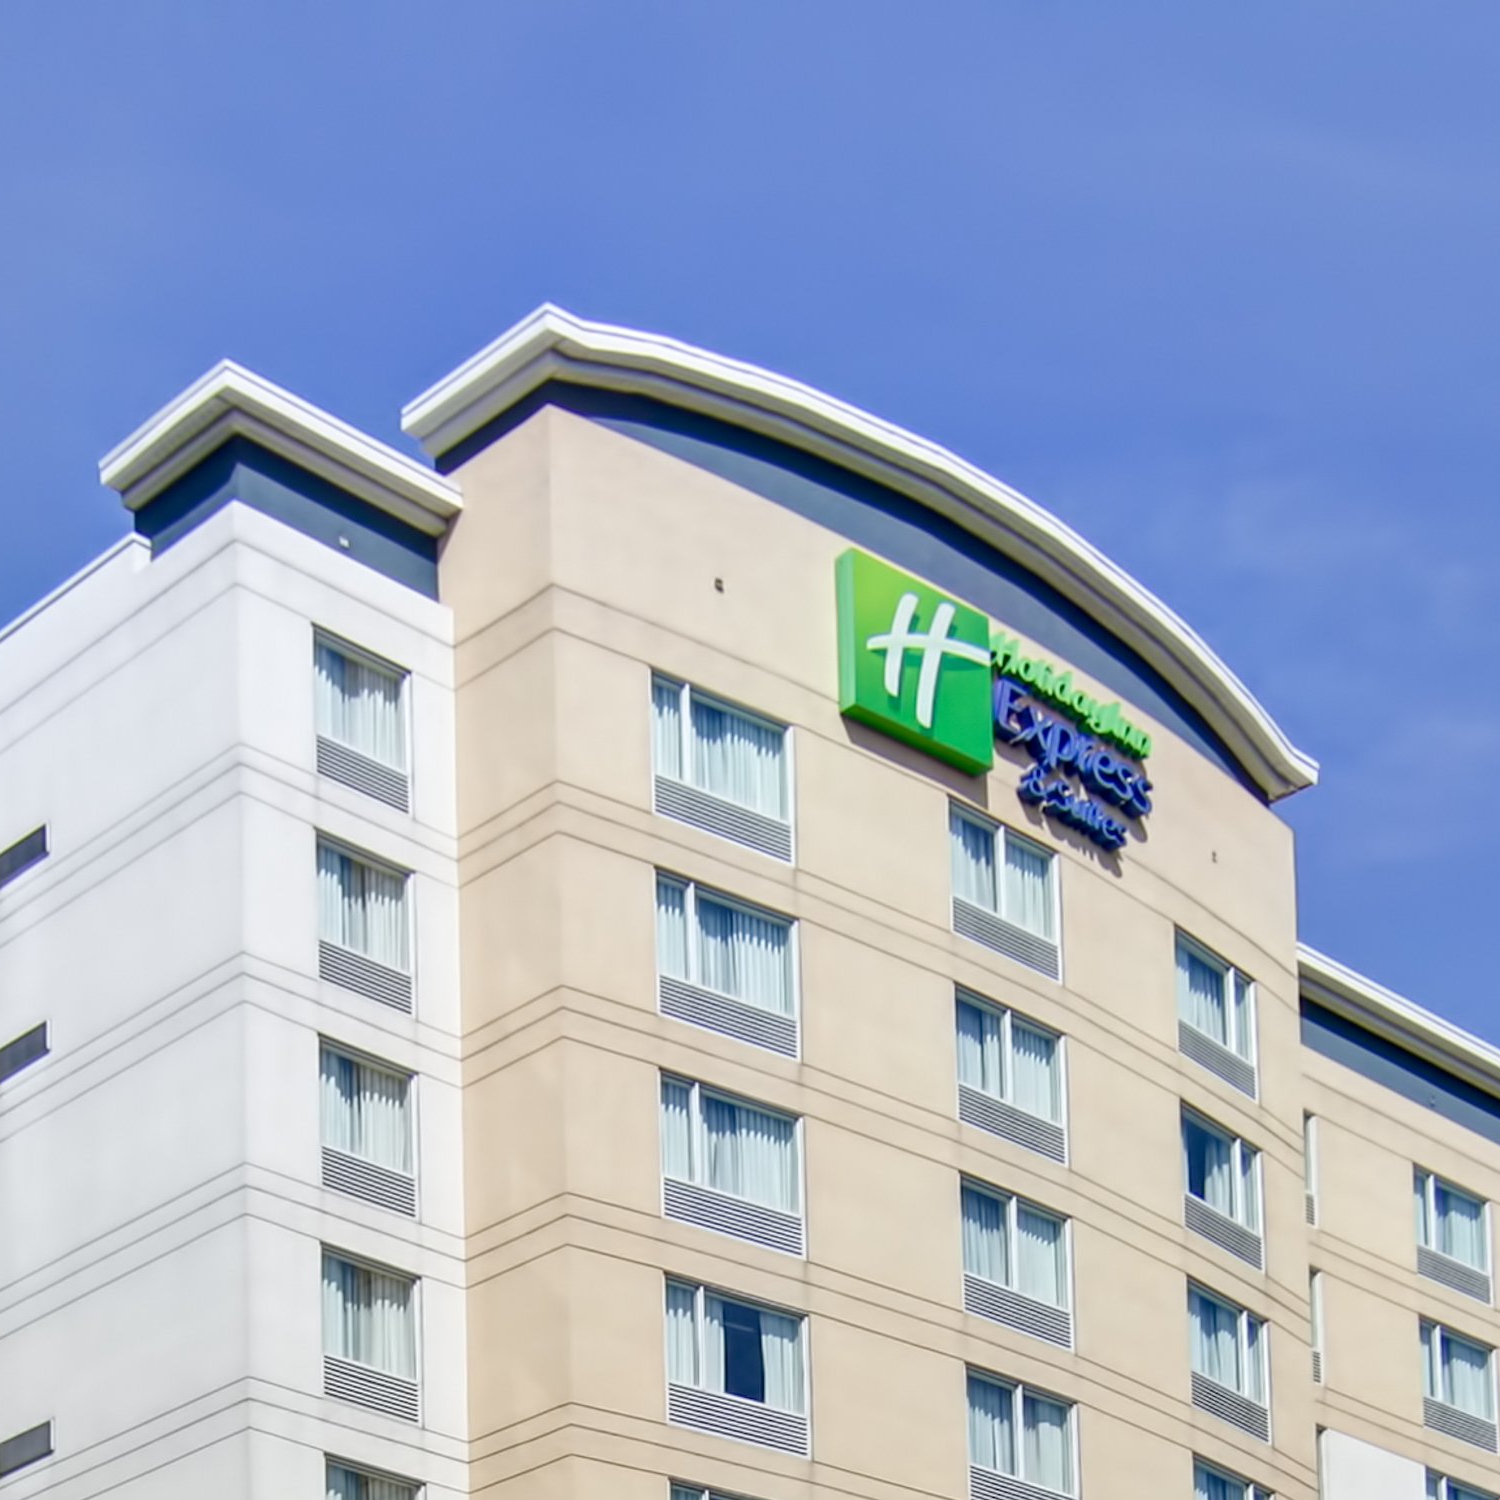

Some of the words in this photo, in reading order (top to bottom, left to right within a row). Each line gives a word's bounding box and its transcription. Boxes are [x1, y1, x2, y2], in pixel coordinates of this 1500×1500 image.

[990, 631, 1108, 734] Holiday
[1104, 702, 1154, 760] Inn
[993, 677, 1153, 816] Express
[1016, 762, 1047, 798] &
[1041, 780, 1128, 849] Suites
